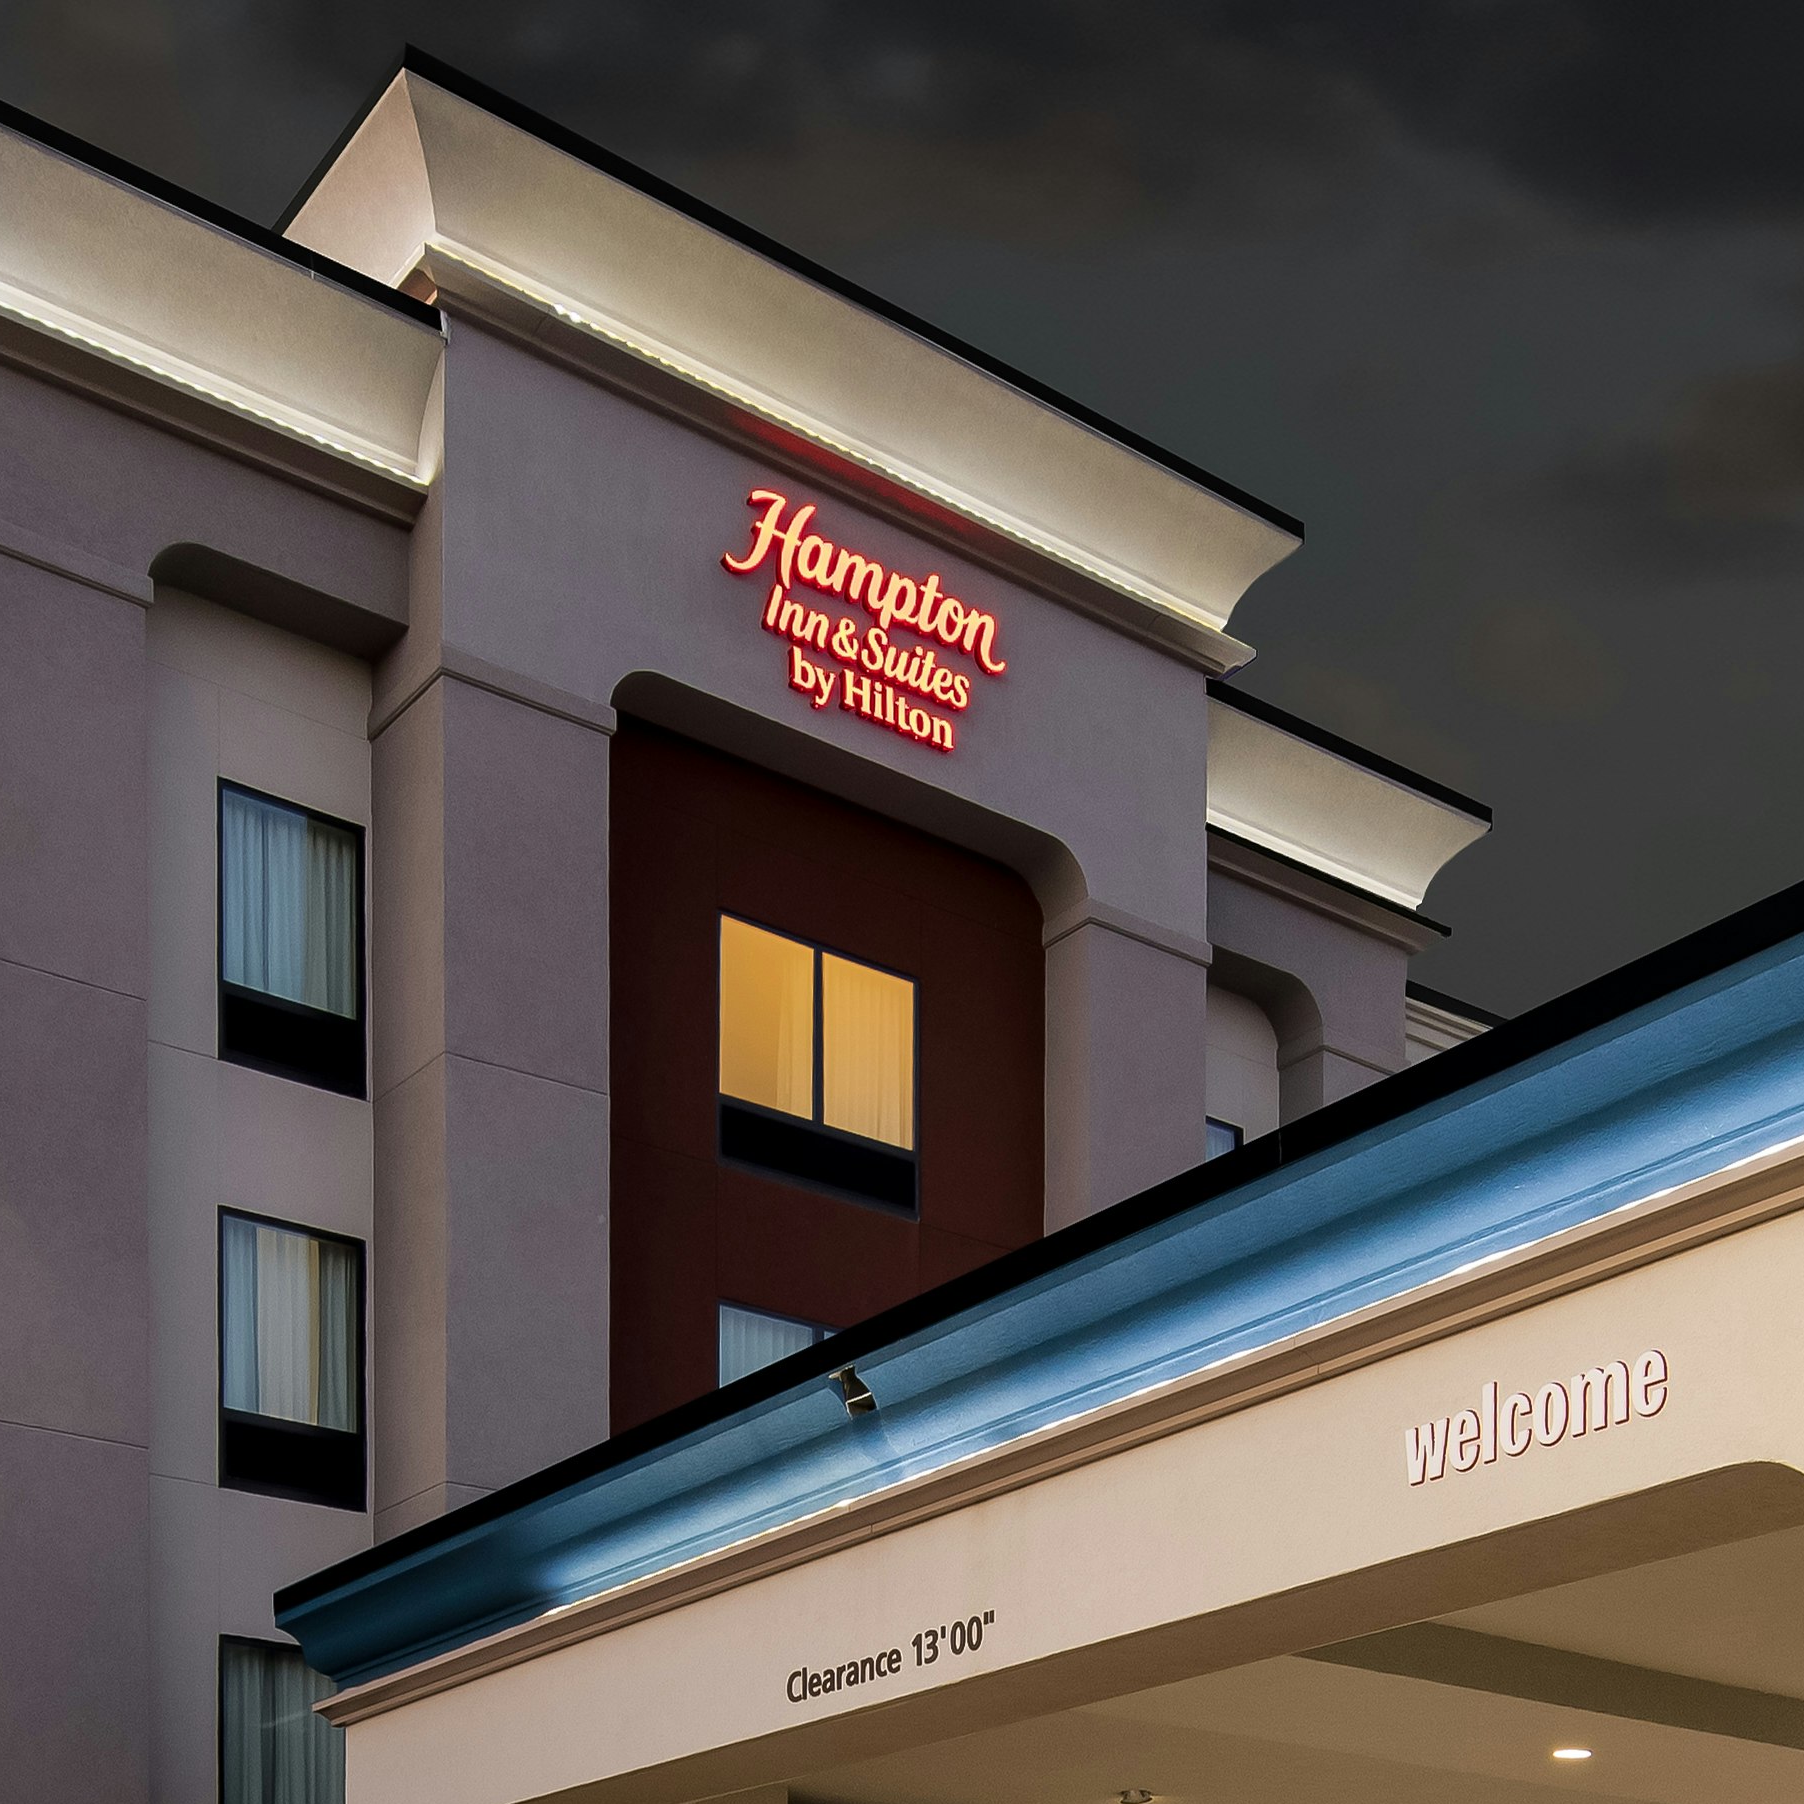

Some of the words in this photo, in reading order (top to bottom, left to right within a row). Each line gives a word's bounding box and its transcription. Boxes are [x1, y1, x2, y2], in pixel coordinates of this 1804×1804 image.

[721, 489, 1006, 674] Hampton
[789, 645, 836, 709] by
[840, 669, 955, 752] Hilton
[1405, 1349, 1668, 1486] welcome
[786, 1647, 902, 1702] Clearance
